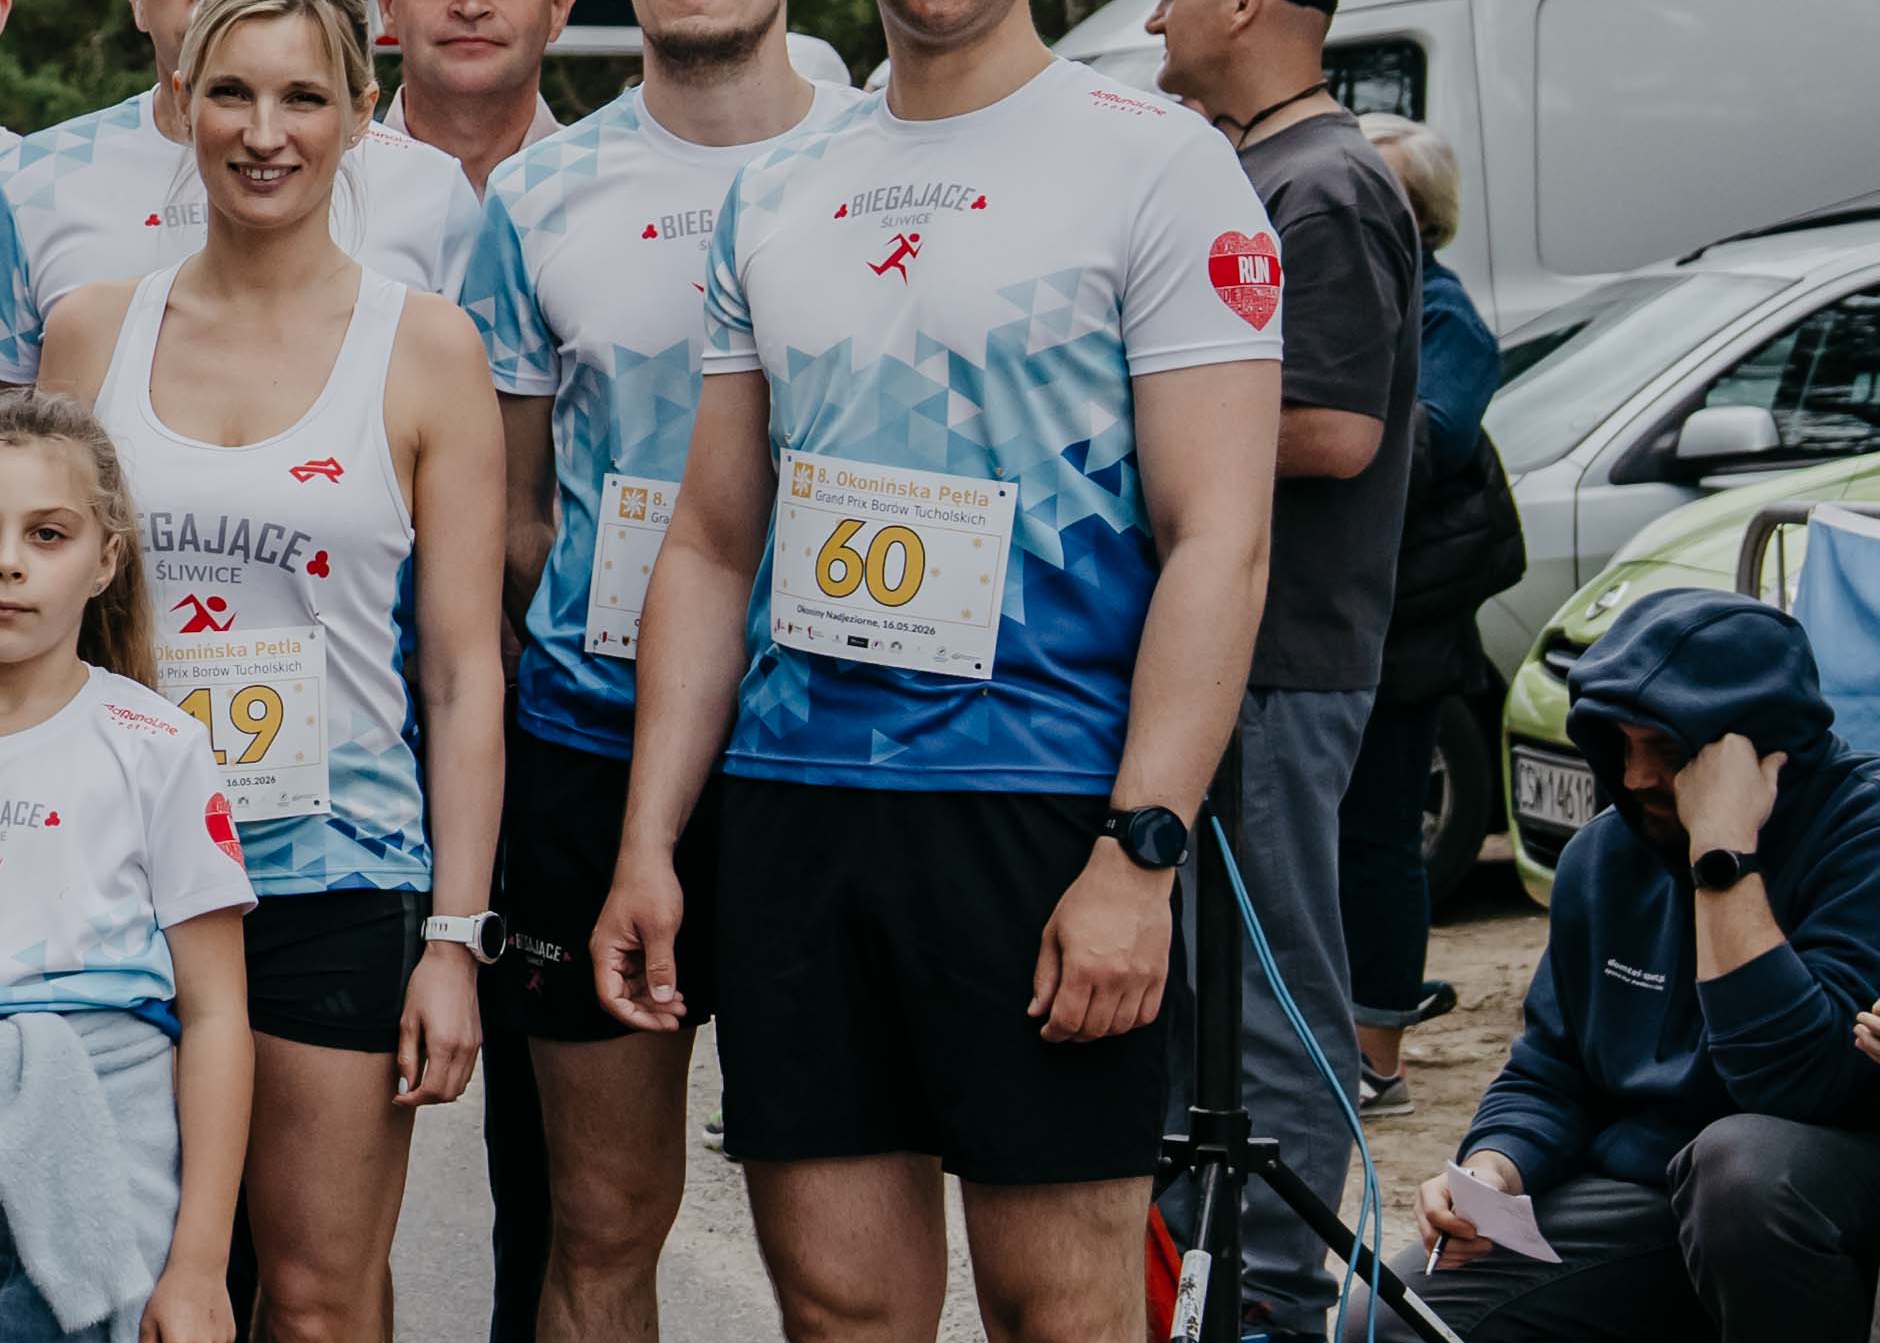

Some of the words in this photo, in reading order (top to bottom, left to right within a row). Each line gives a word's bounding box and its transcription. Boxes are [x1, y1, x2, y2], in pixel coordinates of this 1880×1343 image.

[851, 182, 976, 218] BIEGAJĄCE
[880, 212, 933, 228] ŚLIWICE
[1238, 255, 1270, 284] RUN
[652, 491, 667, 507] 8.
[817, 468, 830, 485] 8.
[836, 471, 931, 499] Okonińska
[939, 485, 990, 507] Pętla
[651, 512, 671, 524] Gra
[815, 490, 844, 506] Grand
[847, 495, 867, 509] Prix
[871, 498, 909, 516] Borów
[914, 505, 986, 526] Tucholskich
[138, 512, 312, 574] GAJĄCE
[155, 560, 242, 584] ŚLIWICE
[815, 518, 926, 607] 60
[882, 619, 936, 636] 16.05.2026
[167, 666, 189, 679] Prix
[192, 665, 230, 678] Borów
[234, 661, 302, 676] Tucholskich
[226, 776, 277, 787] 16.05.2026
